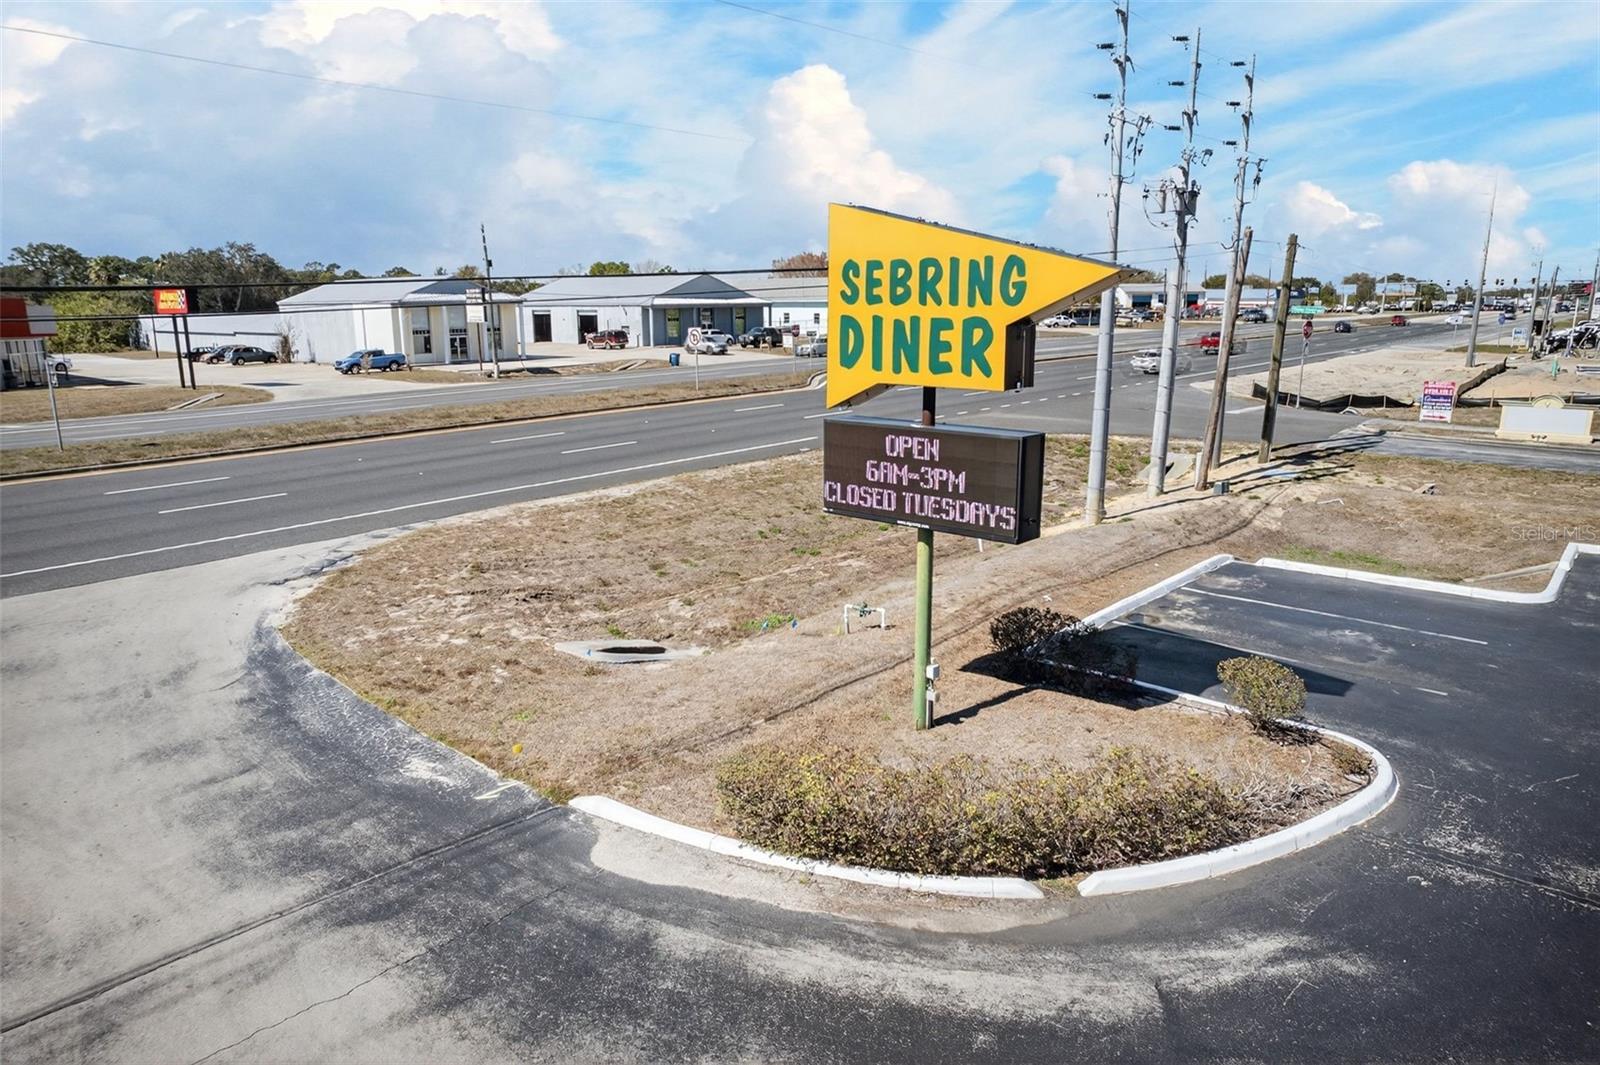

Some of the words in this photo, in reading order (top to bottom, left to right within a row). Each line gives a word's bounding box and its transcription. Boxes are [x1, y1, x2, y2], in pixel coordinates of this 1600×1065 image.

[840, 255, 1027, 308] SEBRING
[839, 314, 994, 378] DINER
[885, 434, 940, 462] OPEN
[866, 459, 966, 494] 6AM-3PM
[823, 480, 897, 512] CLOSED
[902, 491, 1017, 530] TUESDAYS
